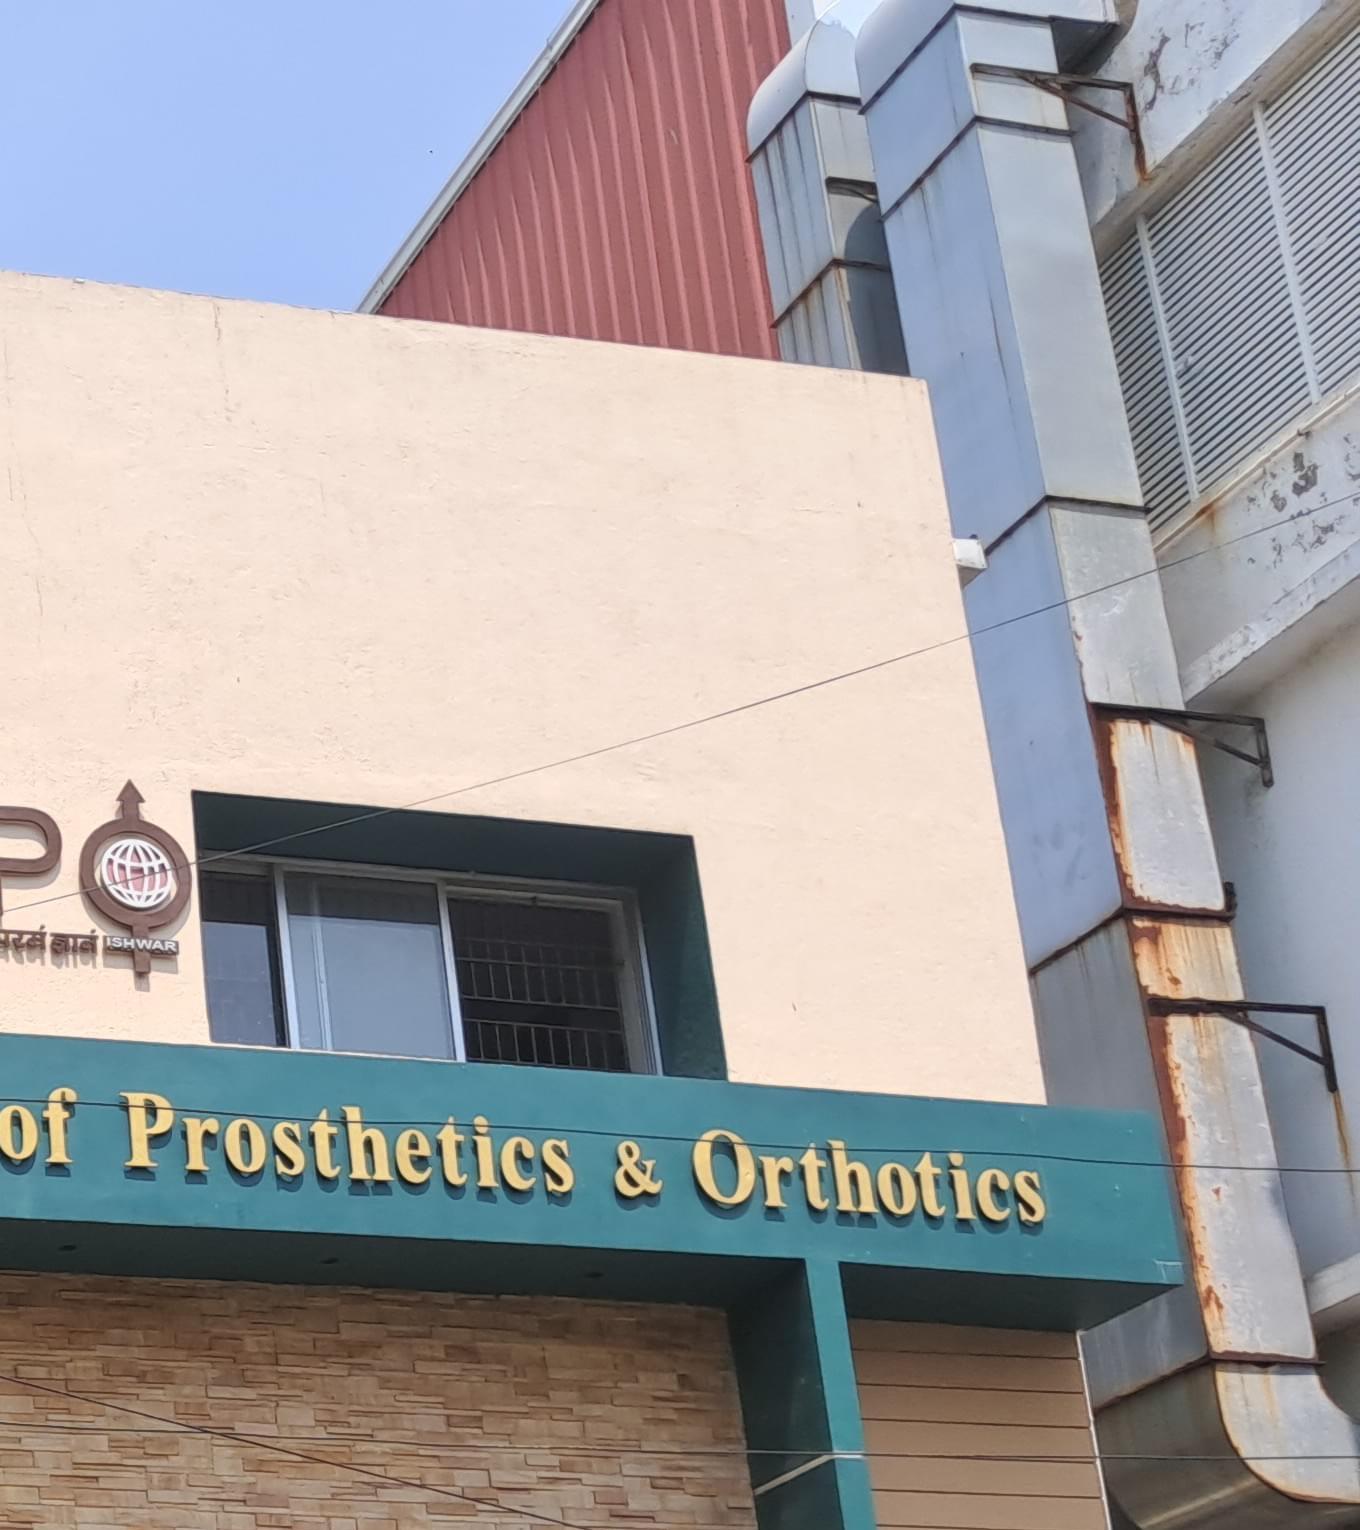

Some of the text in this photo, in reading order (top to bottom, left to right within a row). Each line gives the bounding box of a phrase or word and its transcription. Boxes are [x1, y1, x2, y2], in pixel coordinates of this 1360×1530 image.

[106, 936, 178, 951] ISHWAR
[121, 1089, 576, 1196] Prosthetics
[613, 1138, 662, 1199] &
[693, 1128, 1046, 1224] Orthotics
